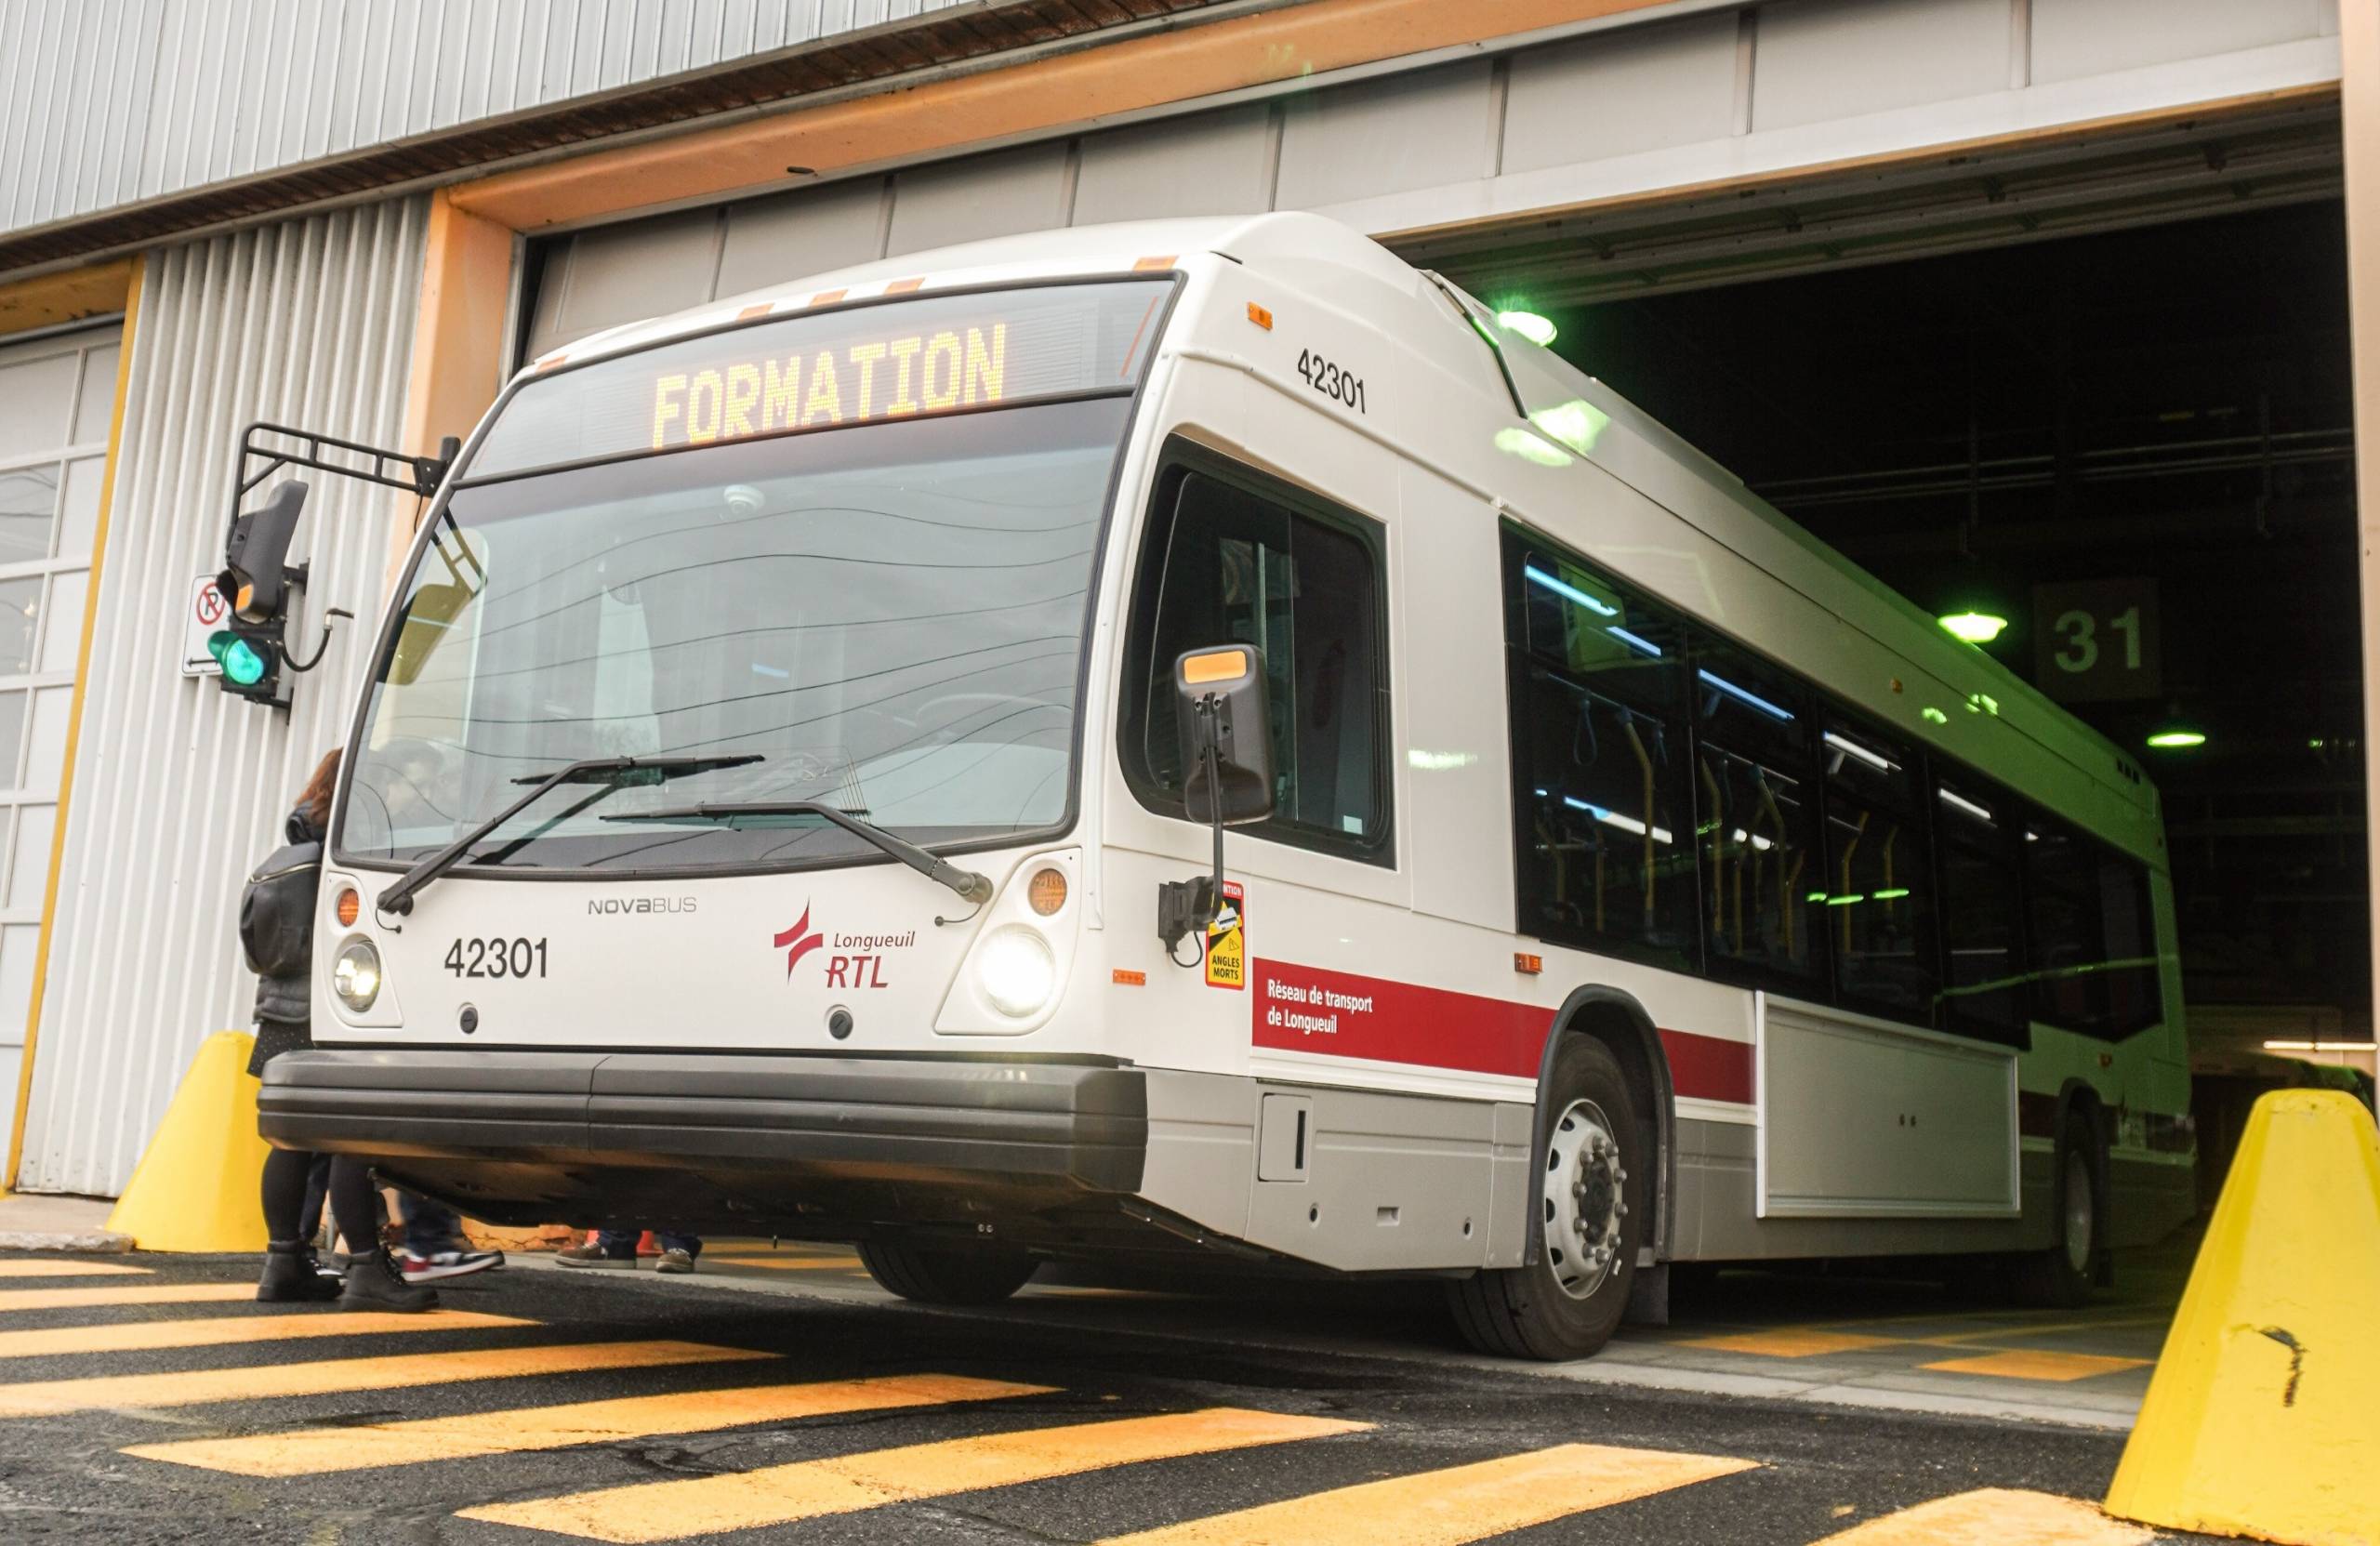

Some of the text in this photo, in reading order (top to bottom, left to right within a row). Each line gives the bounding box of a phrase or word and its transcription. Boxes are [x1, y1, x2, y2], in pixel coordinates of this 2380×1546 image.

[653, 322, 1006, 450] FORMATION
[1298, 348, 1366, 415] 42301
[2055, 608, 2141, 672] 31
[444, 937, 547, 979] 42301
[834, 931, 916, 951] Longueuil
[825, 956, 889, 988] RTL
[1212, 955, 1240, 969] ANGLES
[1213, 968, 1239, 981] MORTS
[1268, 979, 1373, 1015] Réseau de transport
[1268, 1006, 1337, 1035] de Longueuil
